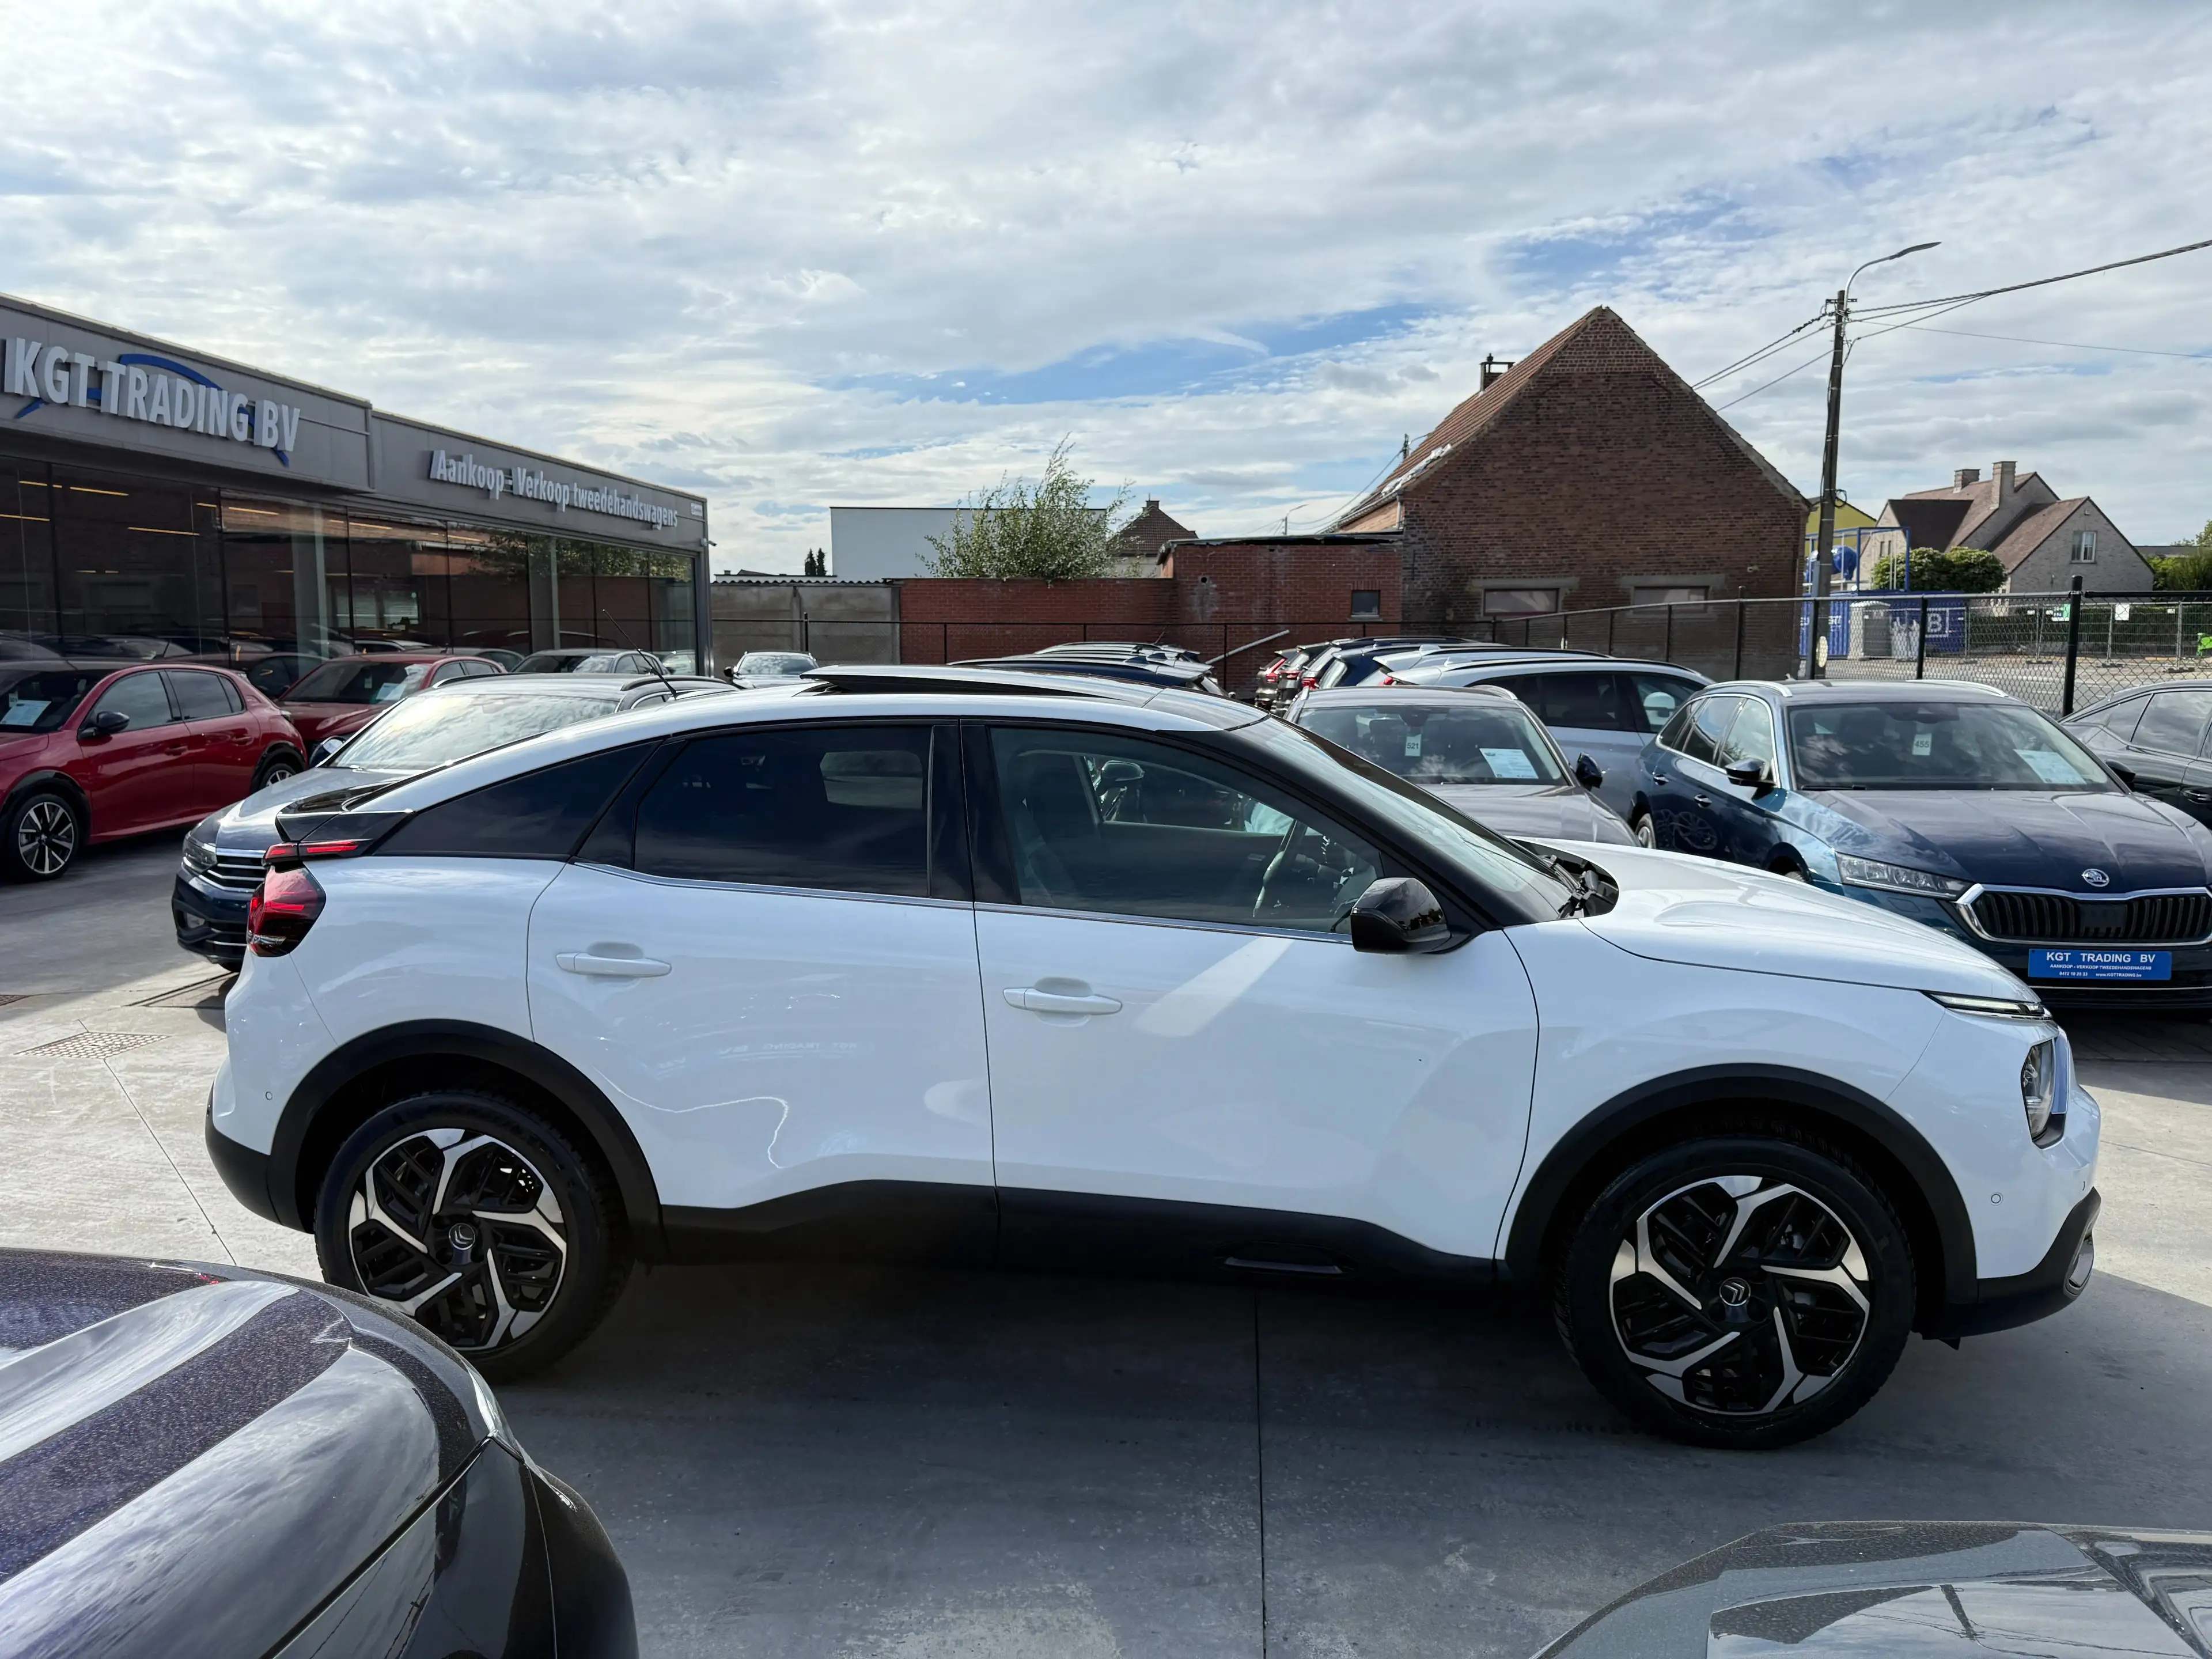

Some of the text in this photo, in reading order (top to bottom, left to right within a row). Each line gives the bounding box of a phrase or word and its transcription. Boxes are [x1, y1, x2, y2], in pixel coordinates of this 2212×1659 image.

[5, 336, 300, 452] KGT TRADING BV
[430, 449, 505, 500] Aankoop
[512, 467, 570, 512] Verkoop
[573, 482, 678, 531] tweedehandswagens
[1915, 740, 1930, 748] 455
[2046, 952, 2156, 963] KGT TRADING BV
